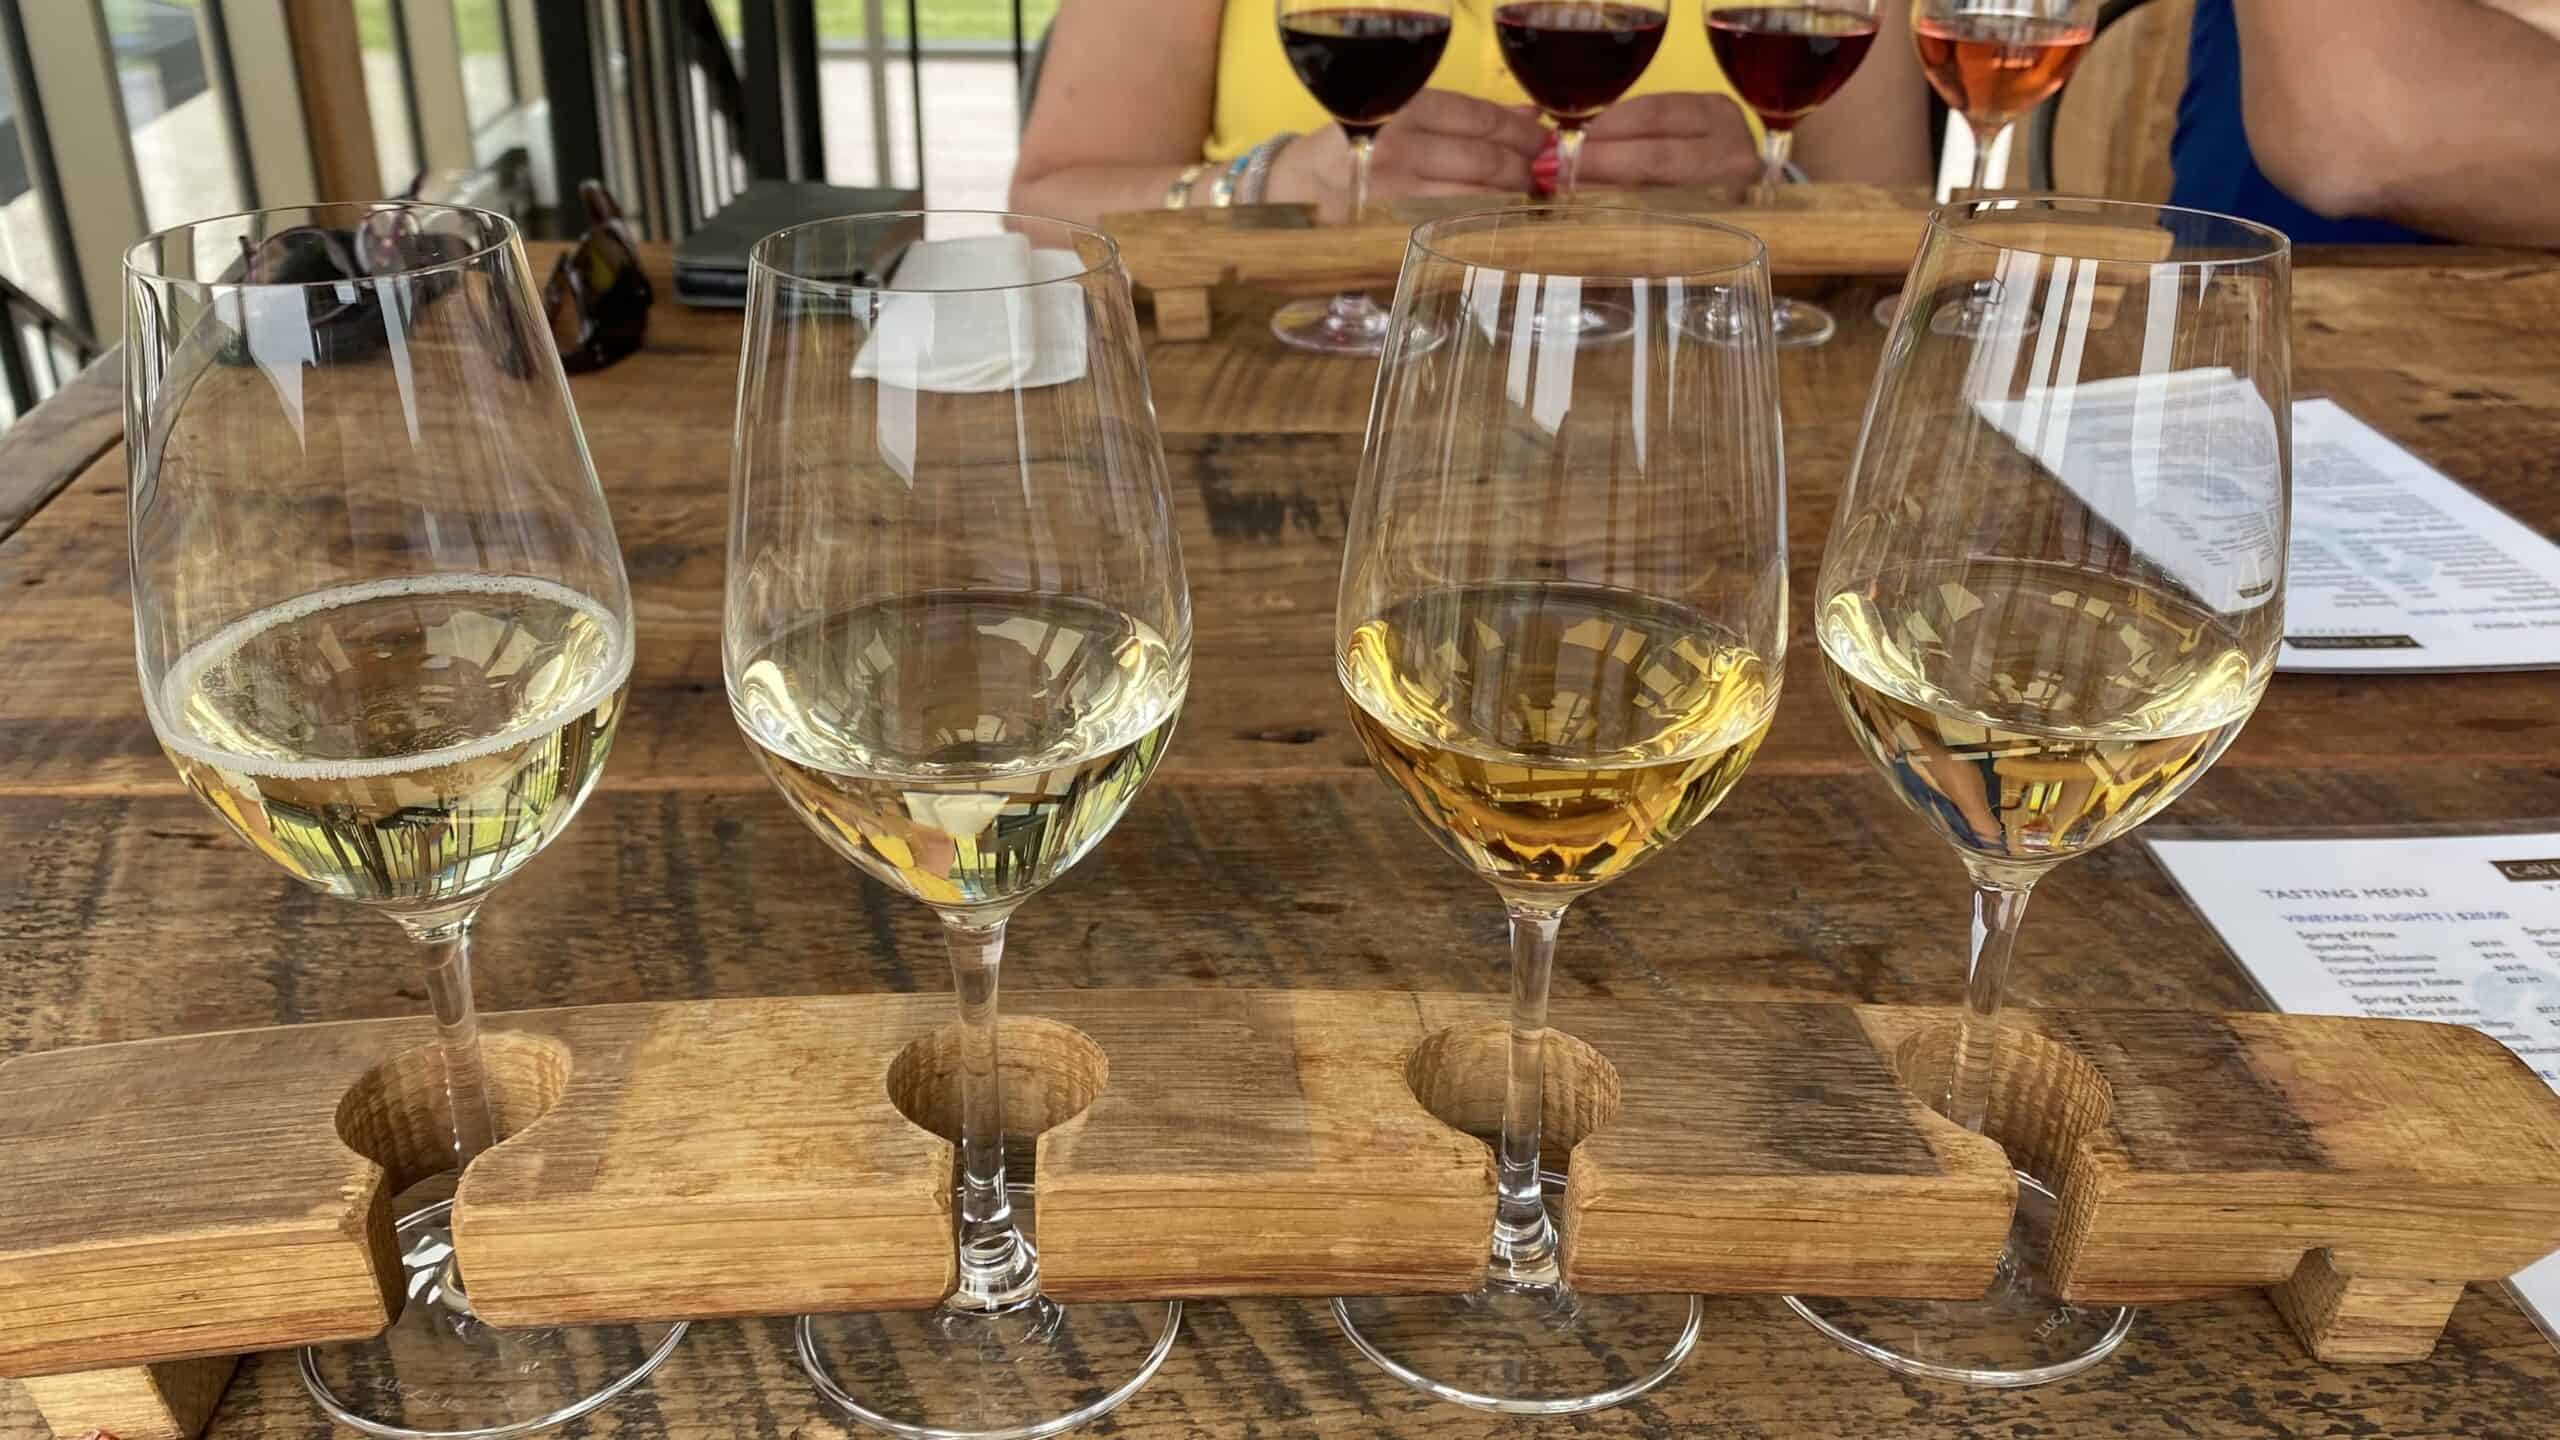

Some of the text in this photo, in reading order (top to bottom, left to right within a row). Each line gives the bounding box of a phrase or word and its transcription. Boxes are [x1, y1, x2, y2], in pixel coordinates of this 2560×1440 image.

[2260, 888, 2428, 900] TASTING MENU
[2282, 912, 2368, 922] VINEYARD
